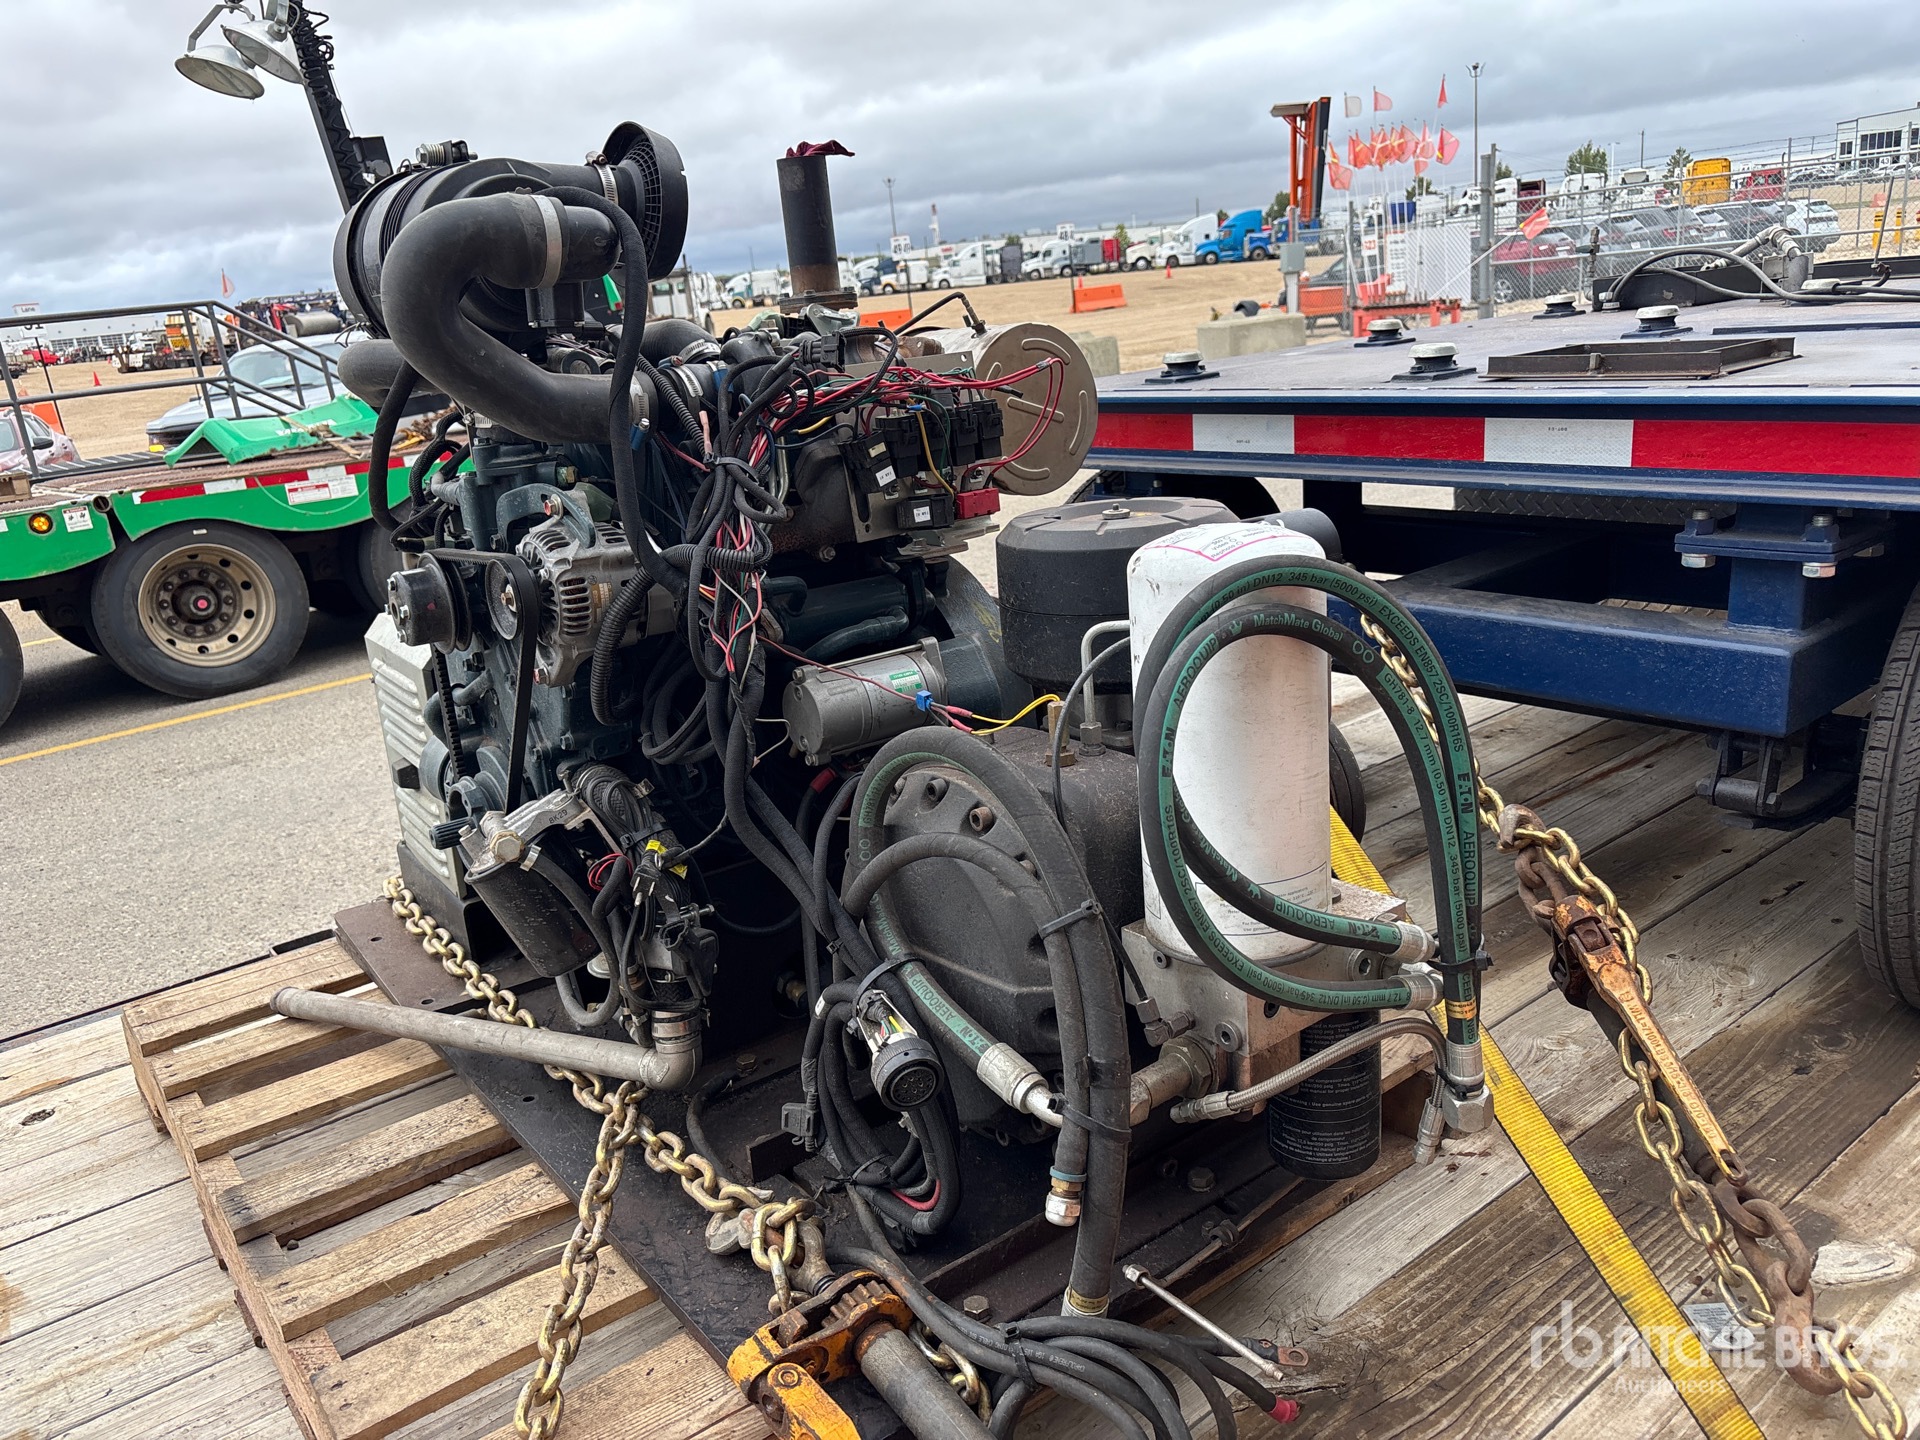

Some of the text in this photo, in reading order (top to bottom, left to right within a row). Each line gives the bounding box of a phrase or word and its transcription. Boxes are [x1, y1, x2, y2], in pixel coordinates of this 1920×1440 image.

[1253, 612, 1310, 629] MatchMate
[1311, 618, 1344, 643] Global
[1173, 637, 1219, 710] AEROQUIP
[1383, 672, 1415, 715] GH781-8
[1252, 572, 1284, 589] DN12
[1287, 571, 1309, 583] 345
[1309, 572, 1329, 586] bar
[1329, 577, 1360, 596] (5000
[1357, 591, 1379, 608] psi)
[1377, 605, 1420, 648] EXCEEDS
[1414, 644, 1439, 680] EN857
[1432, 678, 1465, 754] 2SC/100R16S
[1462, 830, 1479, 907] AEROQUIP
[1413, 718, 1430, 741] 12.7
[1424, 743, 1437, 767] mm
[1431, 767, 1447, 797] (0.50
[548, 809, 568, 824] 8K29
[1439, 798, 1451, 815] in)
[1443, 816, 1456, 849] DN12
[1164, 804, 1193, 896] 2SC/100R16S
[1449, 853, 1460, 876] 345
[1452, 876, 1461, 898] bar
[1187, 898, 1212, 934] EN857
[1275, 901, 1336, 931] AEROQUIP
[1453, 899, 1467, 936] (5000
[875, 903, 902, 957] MatchMate
[1207, 930, 1245, 973] EXCEEDS
[1456, 932, 1469, 954] psi)
[1262, 977, 1285, 995] (5000
[1286, 987, 1300, 998] bar
[1299, 990, 1316, 1001] 345
[911, 976, 958, 1023] AEROQUIP
[1318, 996, 1340, 1006] DN12
[978, 1335, 994, 1347] CABLE
